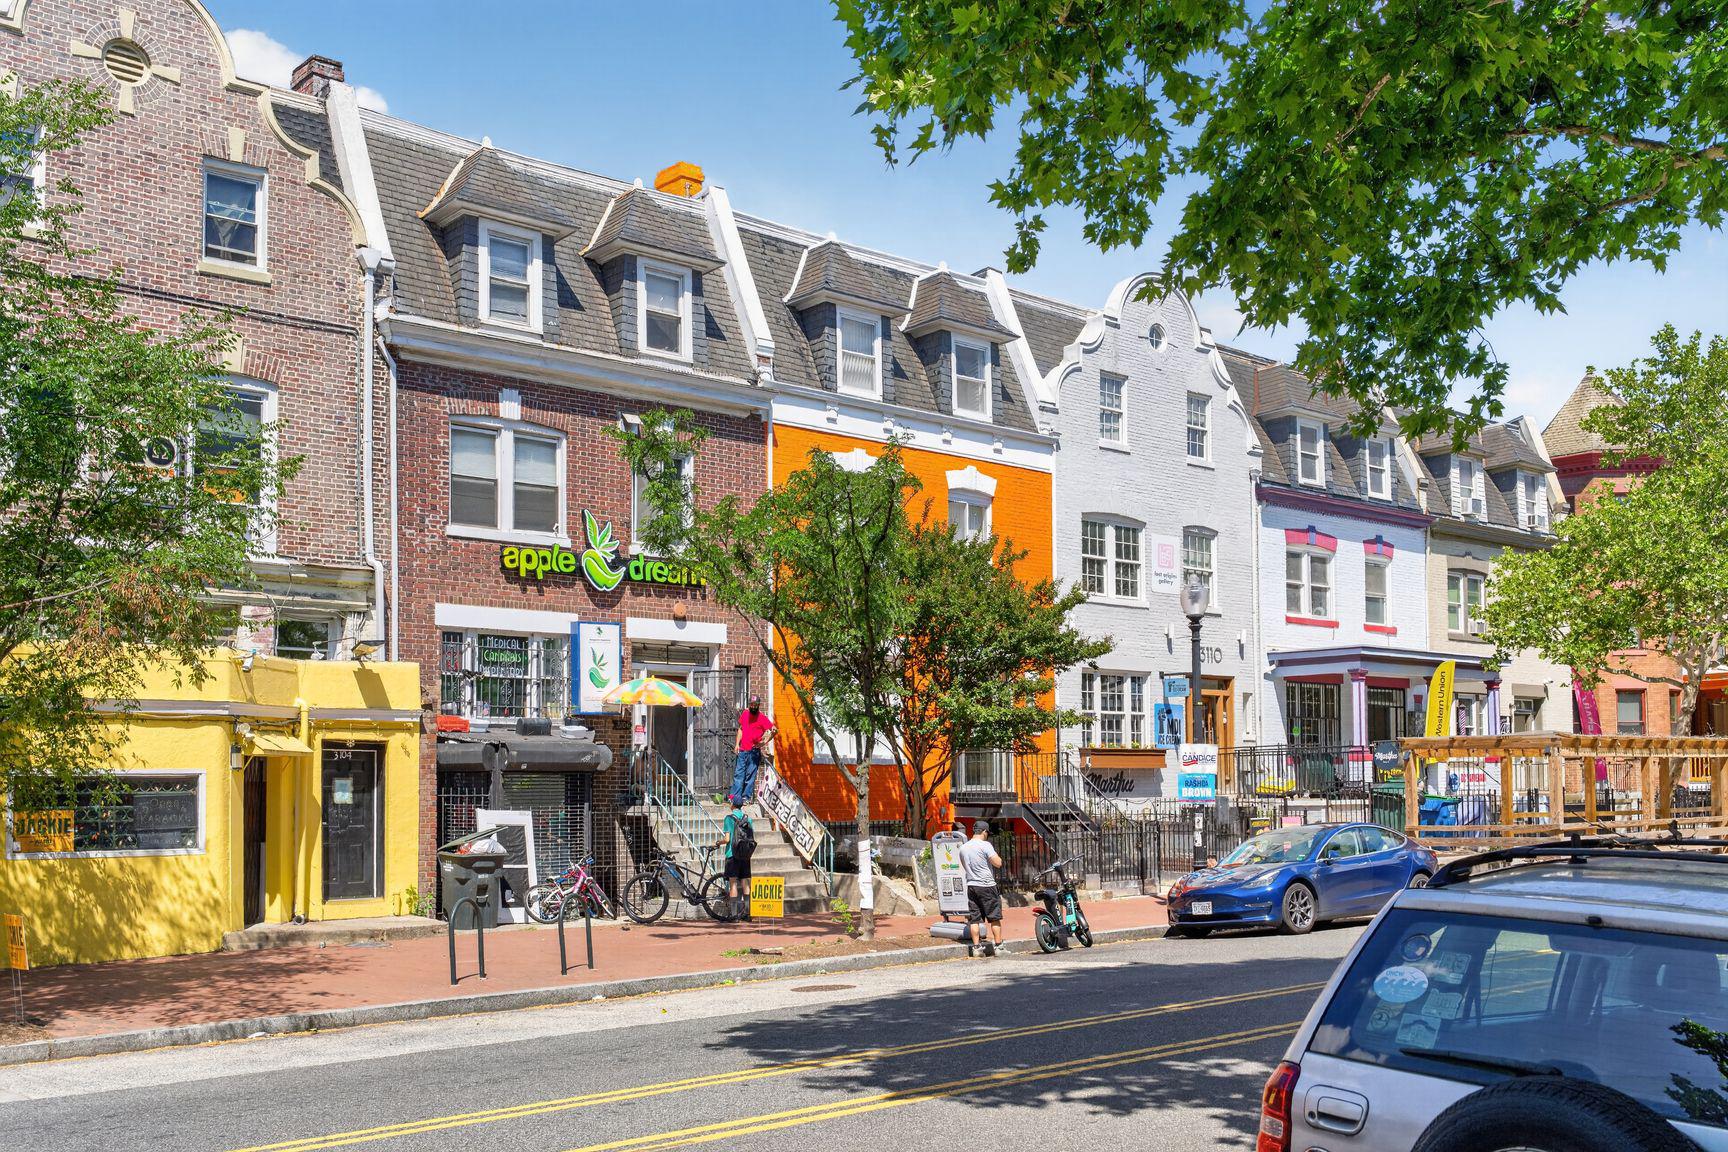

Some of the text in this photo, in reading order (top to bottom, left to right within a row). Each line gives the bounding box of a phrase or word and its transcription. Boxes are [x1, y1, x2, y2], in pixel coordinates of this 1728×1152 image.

[503, 543, 576, 580] apple
[1200, 647, 1222, 664] 3110
[1438, 671, 1446, 699] Union
[1167, 718, 1181, 735] MDI
[333, 751, 353, 760] 3104
[1182, 754, 1217, 762] CANDICE
[1181, 787, 1212, 798] BROWN
[789, 815, 814, 853] OPEN
[751, 884, 782, 900] JACKIE
